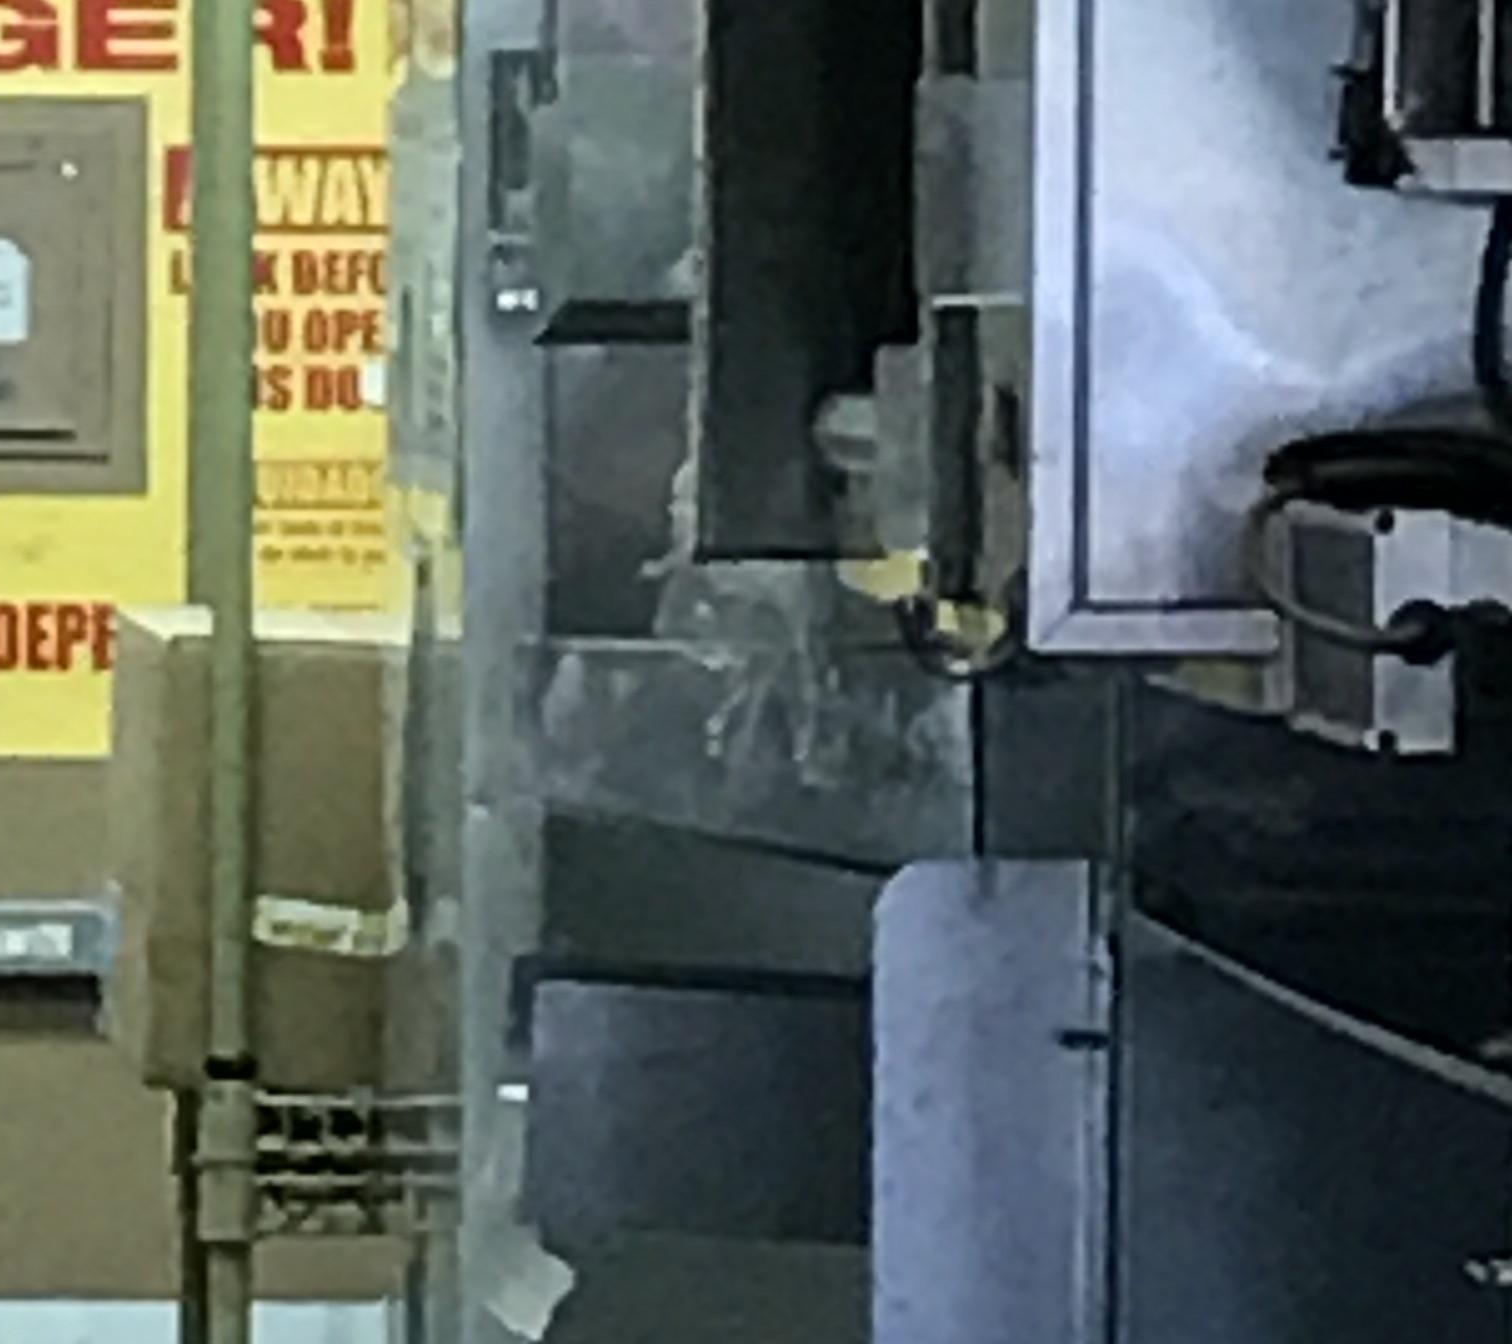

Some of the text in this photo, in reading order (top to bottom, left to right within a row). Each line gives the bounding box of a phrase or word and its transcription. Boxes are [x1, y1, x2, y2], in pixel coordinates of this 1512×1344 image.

[252, 156, 387, 226] WAY
[303, 309, 382, 354] OPE
[305, 364, 362, 412] DO
